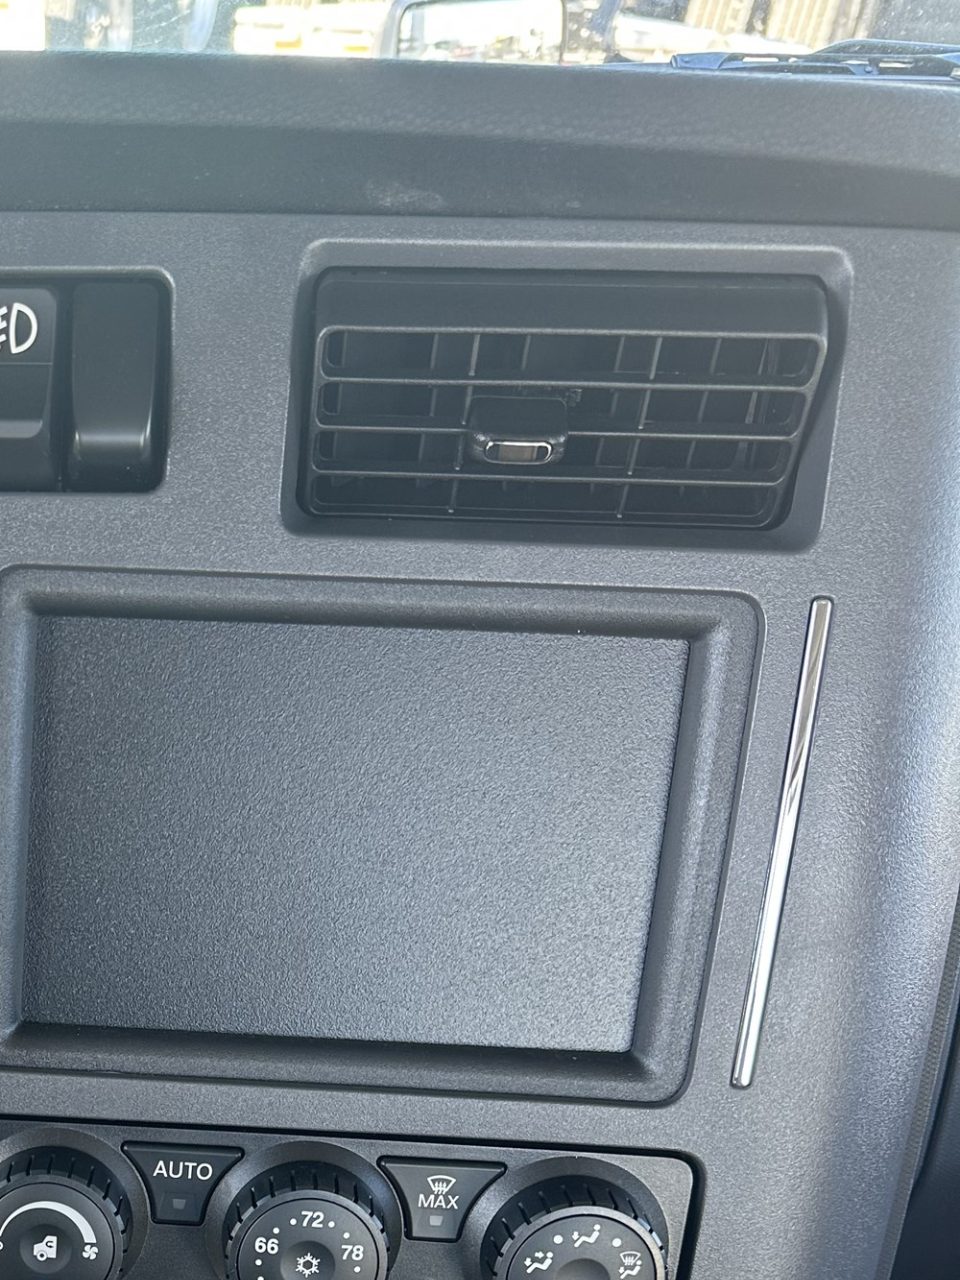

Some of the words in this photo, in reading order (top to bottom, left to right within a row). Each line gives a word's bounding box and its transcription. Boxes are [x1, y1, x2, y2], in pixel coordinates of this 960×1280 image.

[153, 1160, 214, 1180] AUTO
[418, 1194, 459, 1210] MAX
[301, 1211, 324, 1228] 72
[254, 1237, 279, 1254] 66
[341, 1245, 364, 1261] 78
